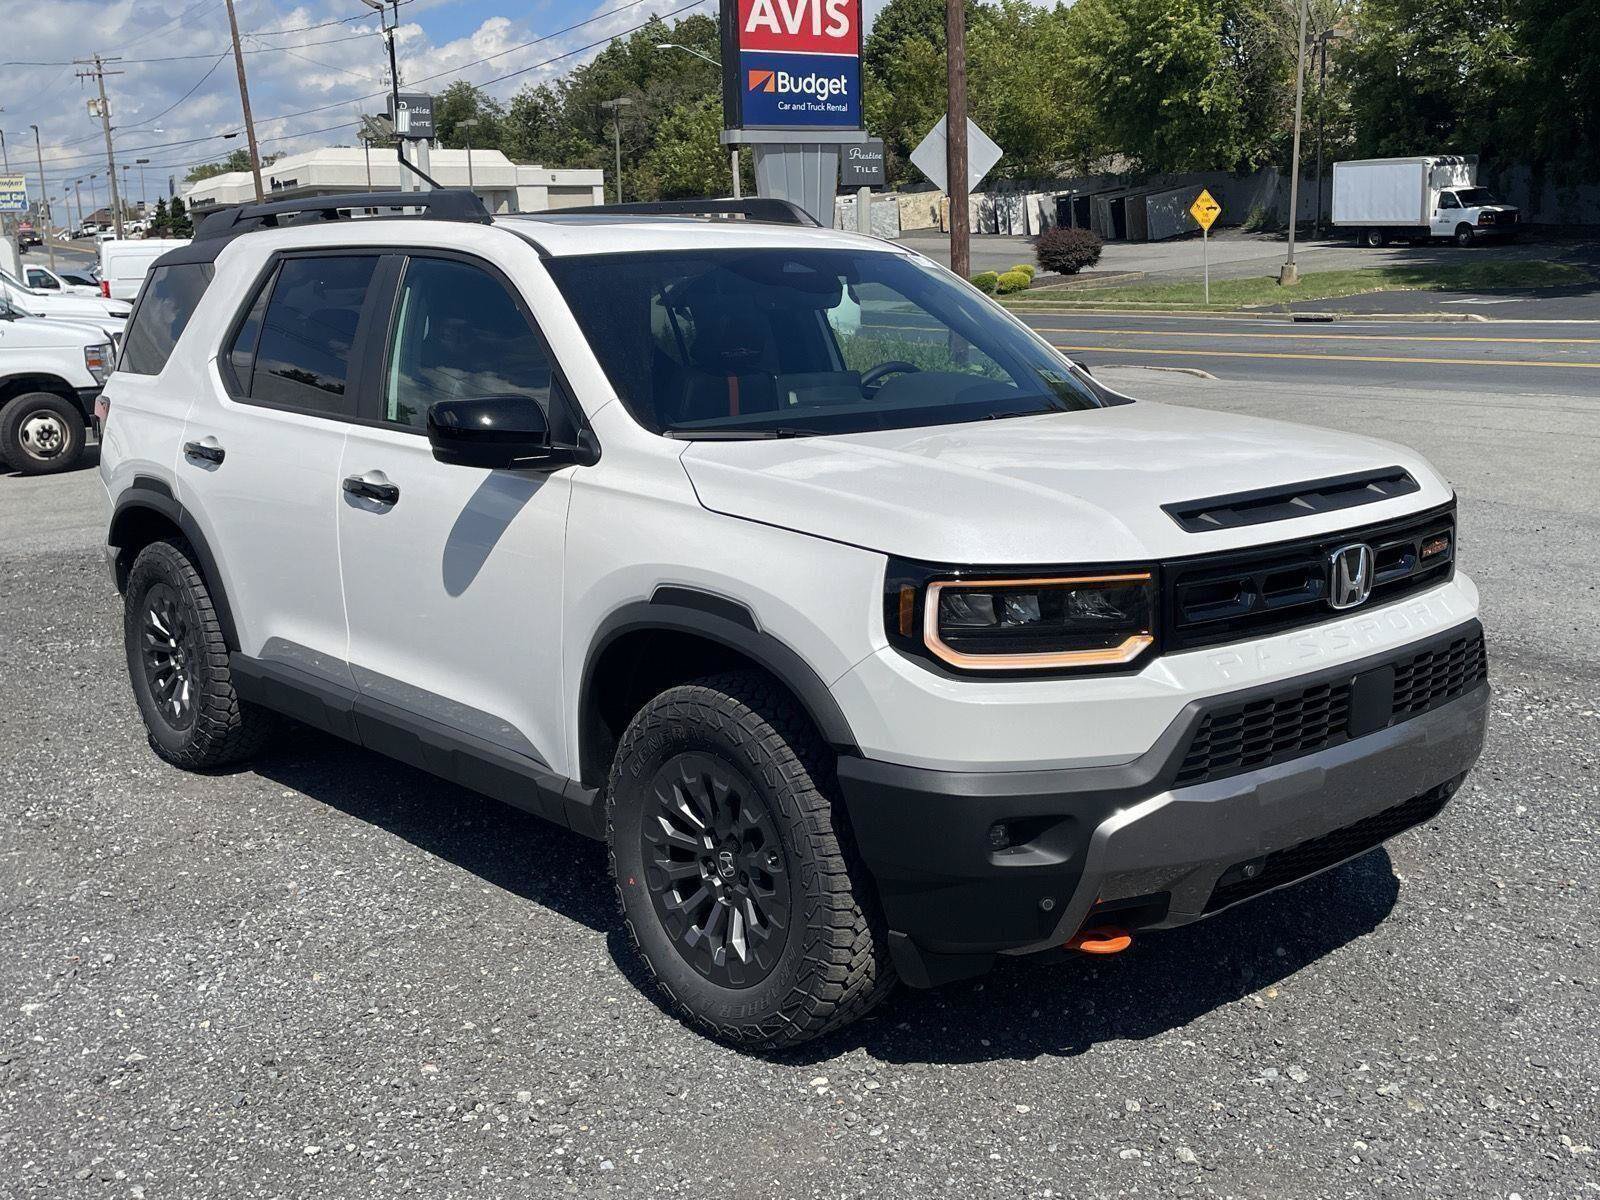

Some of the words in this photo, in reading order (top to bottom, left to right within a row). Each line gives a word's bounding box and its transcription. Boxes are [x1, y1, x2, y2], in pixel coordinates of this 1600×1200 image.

[744, 0, 850, 38] AVIS
[777, 71, 848, 101] Budget
[777, 101, 791, 110] Car
[791, 102, 806, 111] and
[806, 102, 825, 111] Truck
[826, 103, 848, 112] Rental
[853, 165, 879, 173] TILE
